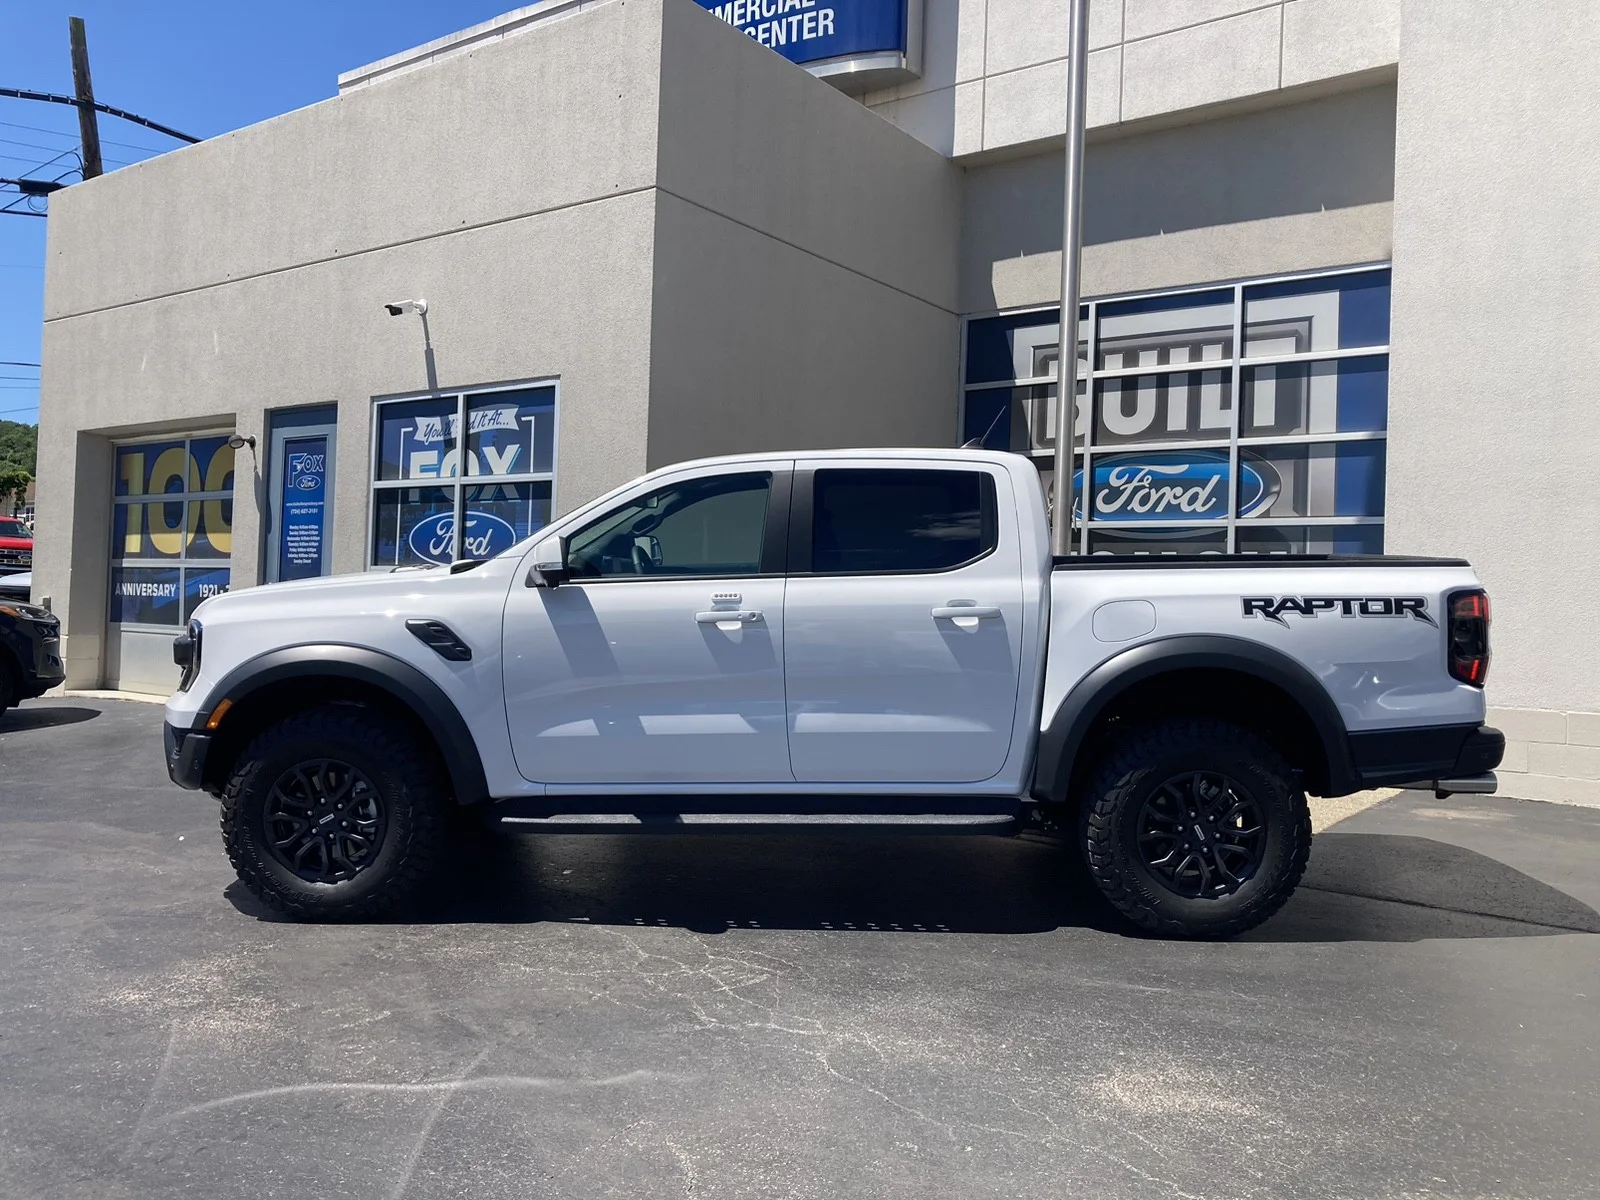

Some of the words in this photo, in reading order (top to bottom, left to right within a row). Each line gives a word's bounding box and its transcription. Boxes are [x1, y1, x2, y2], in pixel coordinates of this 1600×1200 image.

[288, 453, 324, 488] FOX
[409, 444, 521, 503] FOX
[1096, 464, 1221, 513] Ford
[429, 518, 494, 556] Frd
[115, 582, 177, 598] ANNIVERSARY
[199, 583, 218, 598] 1921
[1240, 596, 1439, 629] RAPTOR
